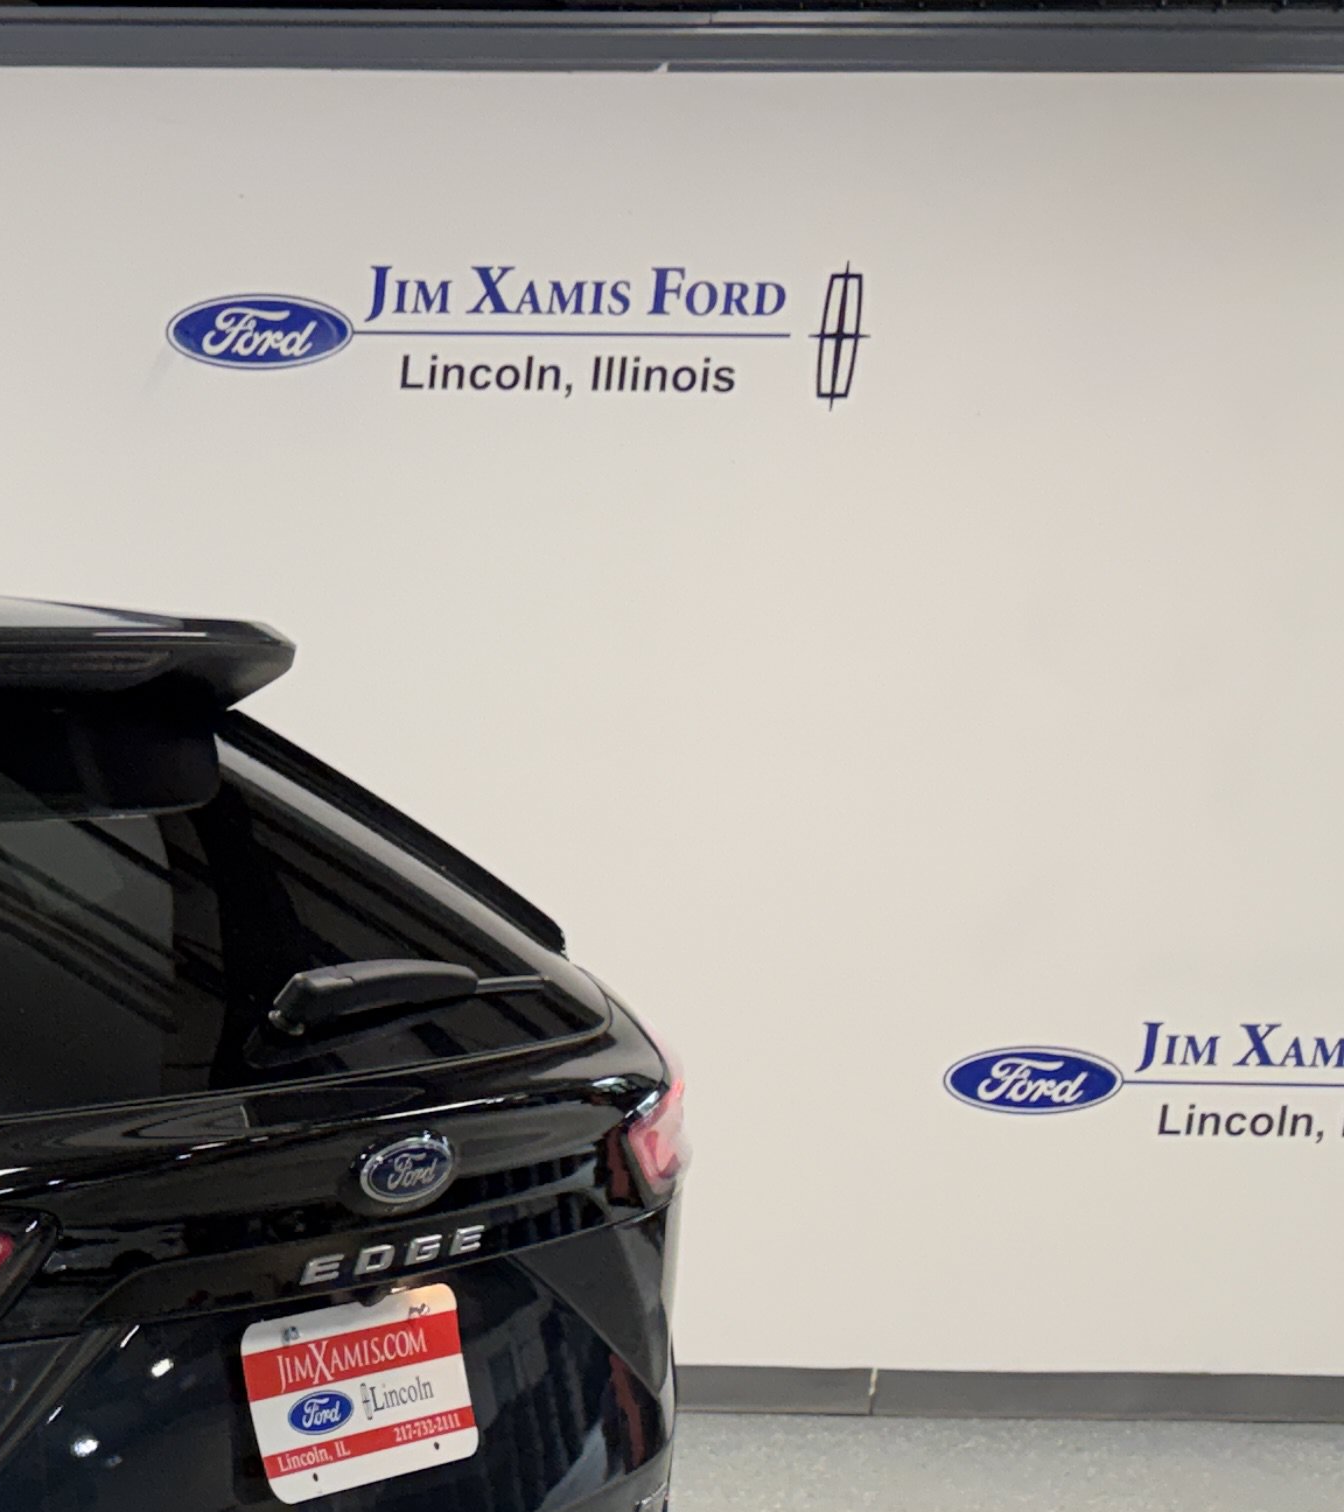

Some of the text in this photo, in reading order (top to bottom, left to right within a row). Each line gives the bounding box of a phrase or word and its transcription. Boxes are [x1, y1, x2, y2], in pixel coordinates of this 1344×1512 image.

[364, 265, 787, 322] JIM XAMIS FORD
[399, 354, 736, 399] Lincoln, Illinois
[1134, 1022, 1221, 1073] JIM
[1157, 1103, 1325, 1145] Lincoln,
[299, 1224, 486, 1286] EDGE
[368, 1375, 436, 1414] Lincoln
[276, 1444, 334, 1473] Lincoln,
[335, 1439, 352, 1458] IL
